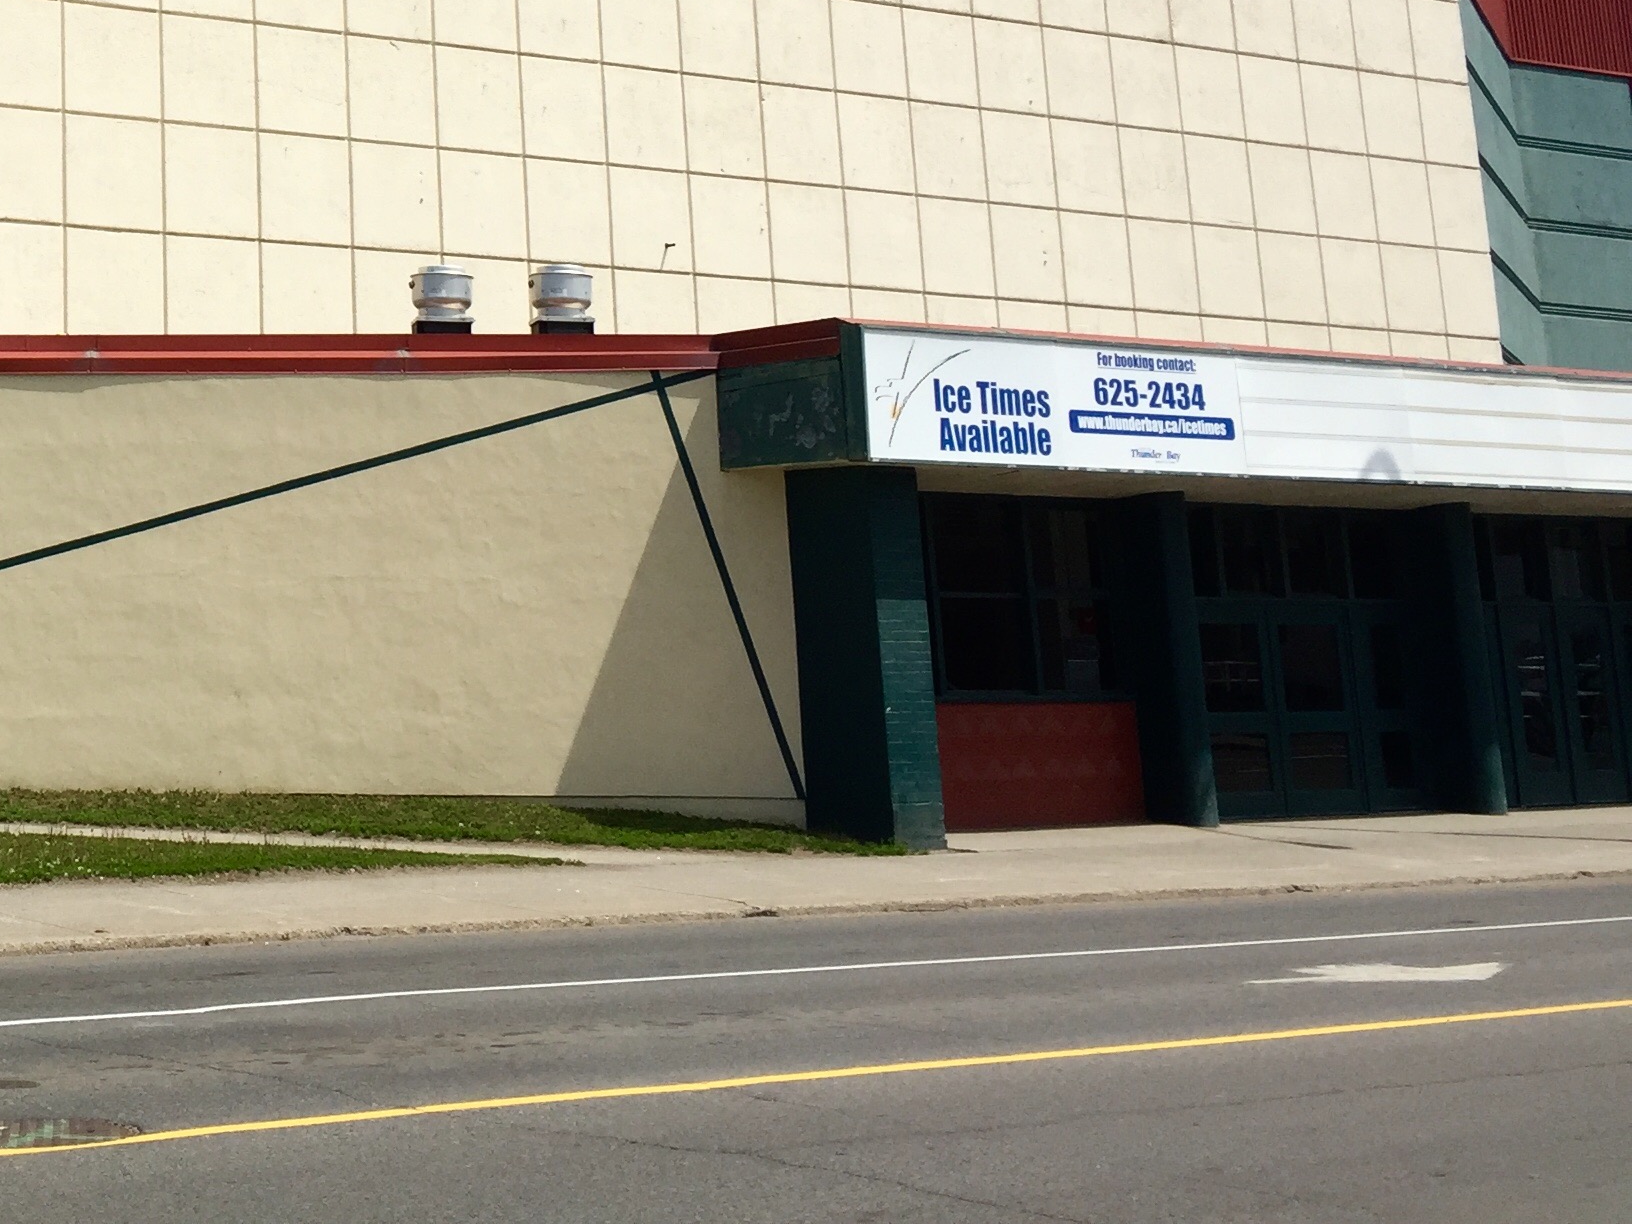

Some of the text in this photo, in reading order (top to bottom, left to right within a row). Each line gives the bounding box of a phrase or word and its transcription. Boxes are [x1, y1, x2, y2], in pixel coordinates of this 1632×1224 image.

[1097, 352, 1112, 366] For
[1114, 353, 1154, 371] booking
[933, 378, 1051, 418] Ice Times
[1094, 377, 1206, 411] 625-2434
[940, 417, 1051, 456] Available
